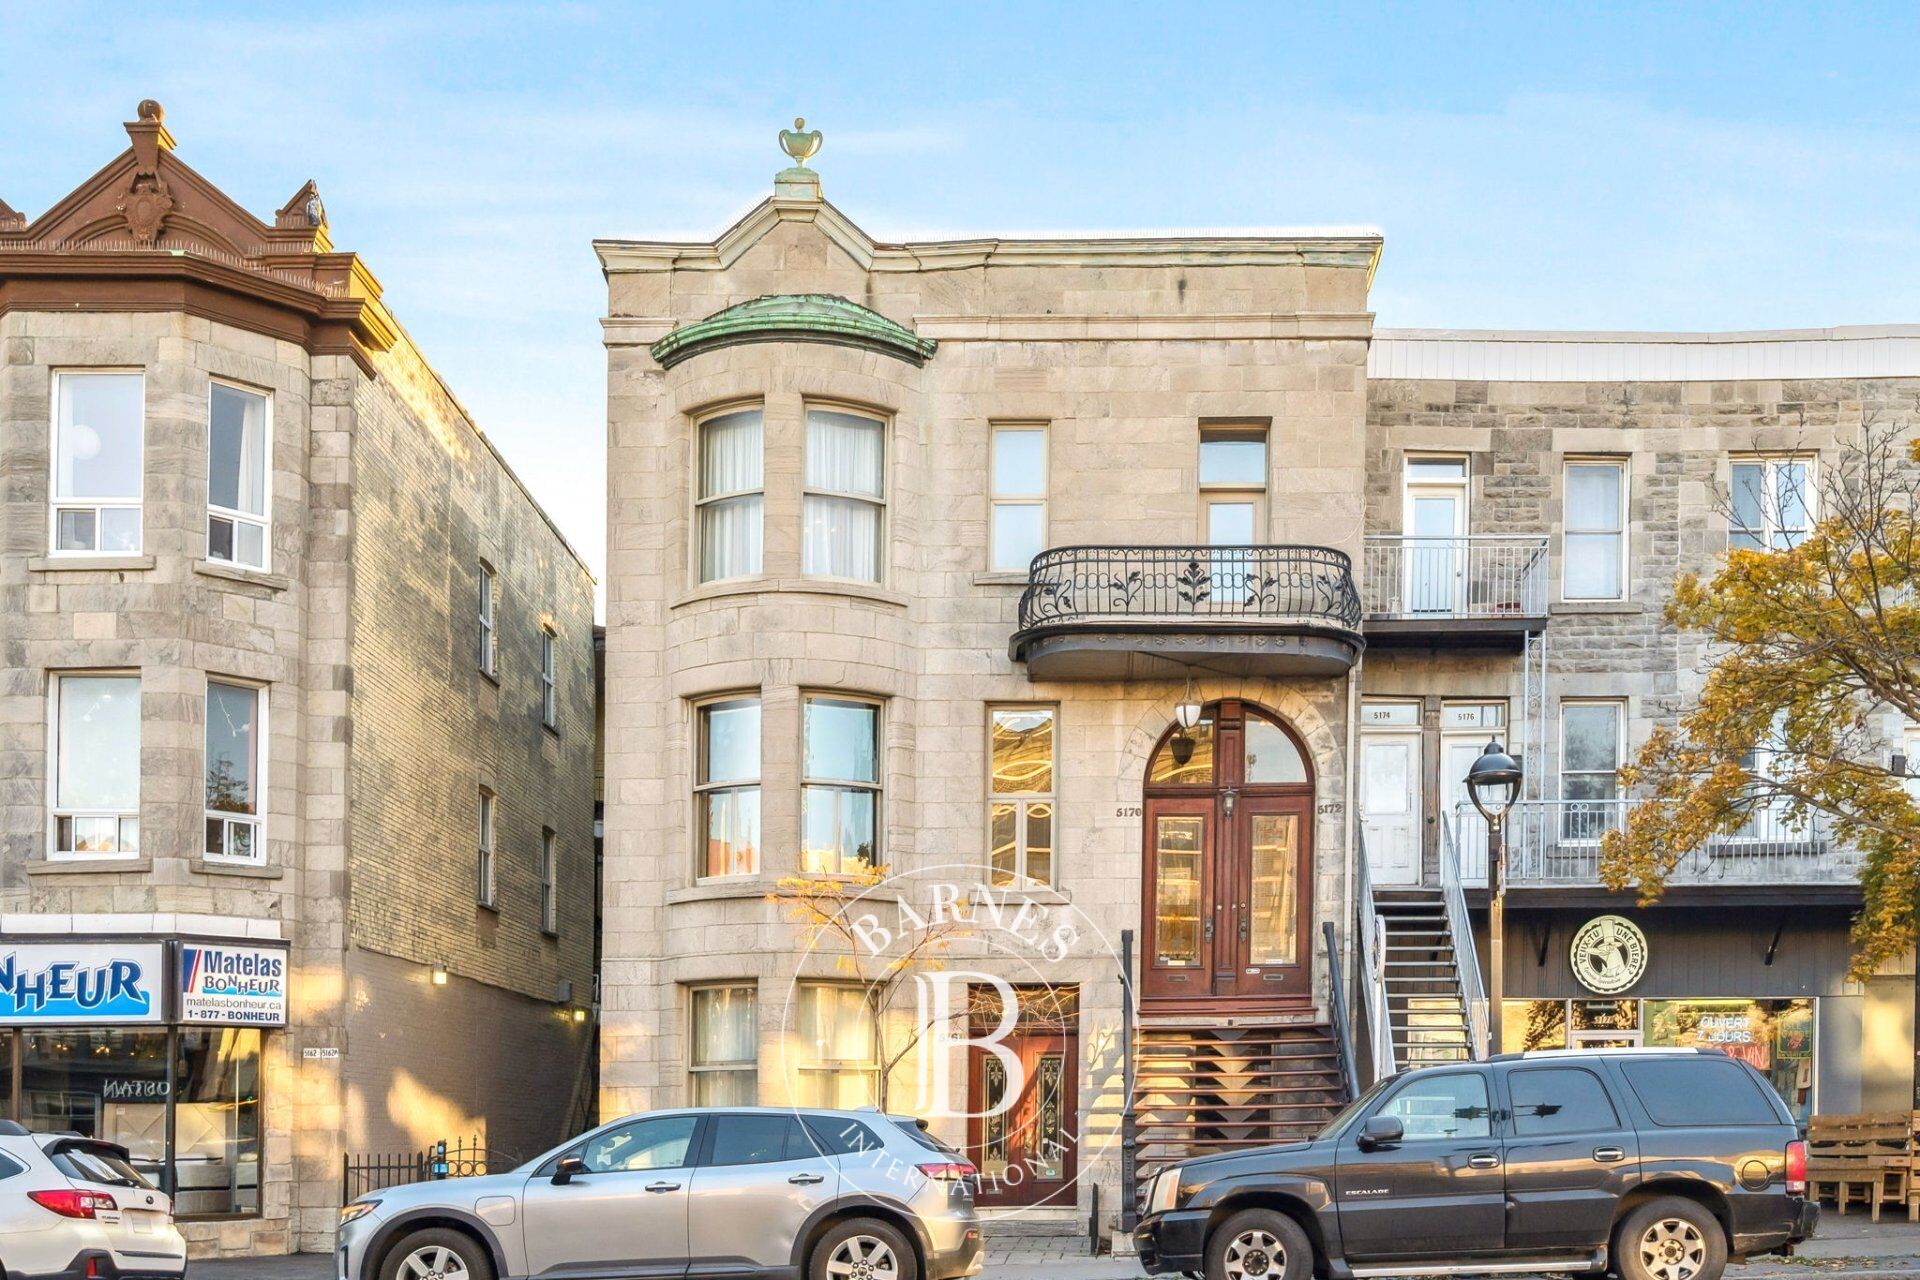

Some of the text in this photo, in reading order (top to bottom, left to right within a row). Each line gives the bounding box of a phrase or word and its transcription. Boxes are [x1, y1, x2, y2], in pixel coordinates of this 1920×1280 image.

[1373, 711, 1390, 720] 5174
[1458, 713, 1475, 721] 5176
[1116, 807, 1142, 818] 5170
[1317, 803, 1342, 815] 5172
[1616, 928, 1633, 942] UNE
[204, 950, 282, 977] Matelas
[204, 975, 281, 994] BONHEUR
[186, 997, 283, 1010] matelasbonheur.ca
[1700, 1016, 1750, 1029] OUVERT
[1709, 1030, 1752, 1043] JOURS
[304, 1049, 317, 1057] 5162
[1742, 1046, 1764, 1068] VIN
